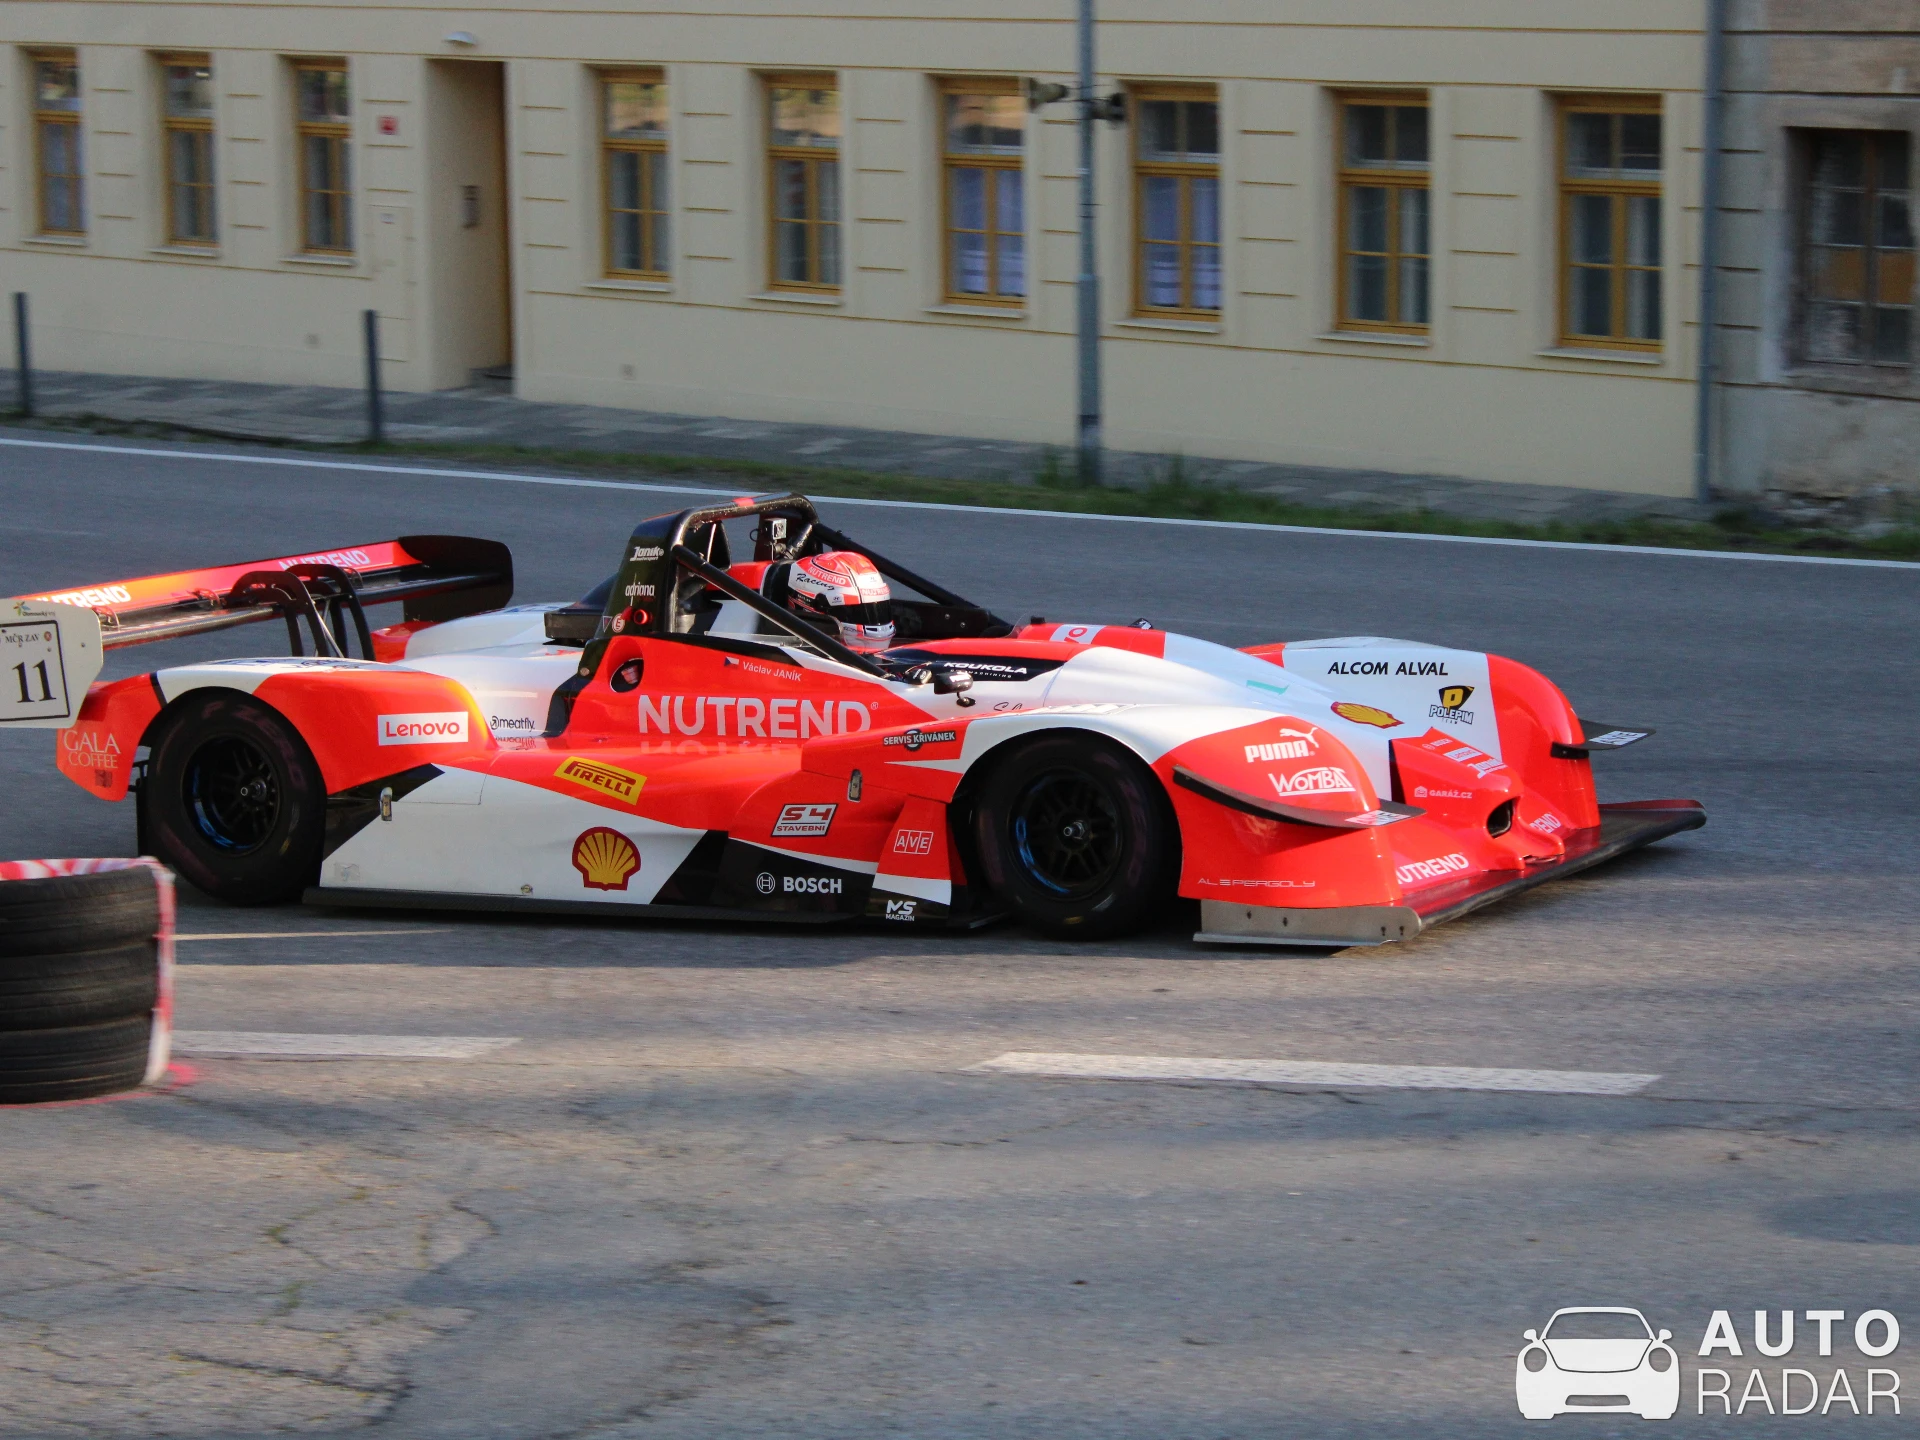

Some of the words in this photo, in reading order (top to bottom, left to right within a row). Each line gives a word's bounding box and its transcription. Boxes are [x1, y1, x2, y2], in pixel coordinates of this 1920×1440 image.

[796, 573, 835, 591] Racing
[808, 566, 846, 585] NUTREND
[743, 661, 772, 675] Václav
[774, 668, 802, 682] JANÍK
[944, 662, 1028, 675] KOUKOLA
[1327, 661, 1389, 675] ALCOM
[1395, 661, 1448, 676] ALVAL
[12, 659, 57, 703] 11
[1429, 704, 1475, 725] POLEPIM
[385, 720, 460, 738] Lenovo
[63, 730, 121, 755] GALA
[883, 735, 912, 746] SERVIS
[913, 731, 956, 744] KŘIVÁNEK
[1244, 740, 1309, 763] PUMA
[68, 753, 119, 769] COFFEE
[563, 760, 637, 797] PIRELLI
[1268, 767, 1355, 794] WOMBAT
[896, 835, 930, 849] AVE
[1396, 852, 1469, 885] UTREND
[783, 876, 842, 894] BOSCH
[886, 899, 917, 916] MS
[885, 914, 915, 922] MAGAZIN
